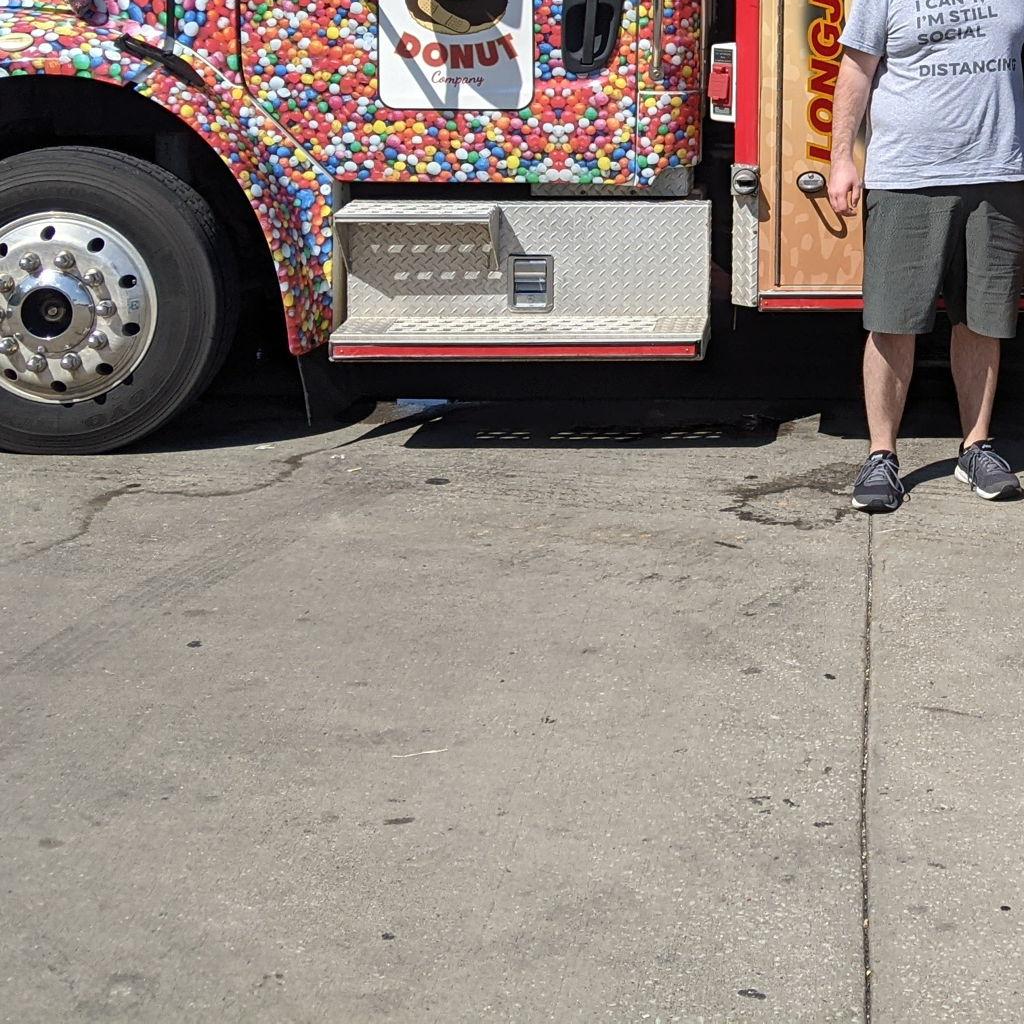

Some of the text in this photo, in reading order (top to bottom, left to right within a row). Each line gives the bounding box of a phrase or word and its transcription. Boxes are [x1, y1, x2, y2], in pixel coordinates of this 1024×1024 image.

[915, 0, 921, 12] I
[916, 5, 998, 29] I'M STILL
[917, 25, 986, 45] SOCIAL
[394, 32, 518, 69] DONUT
[919, 58, 1016, 77] DISTANCING
[431, 70, 485, 86] Company
